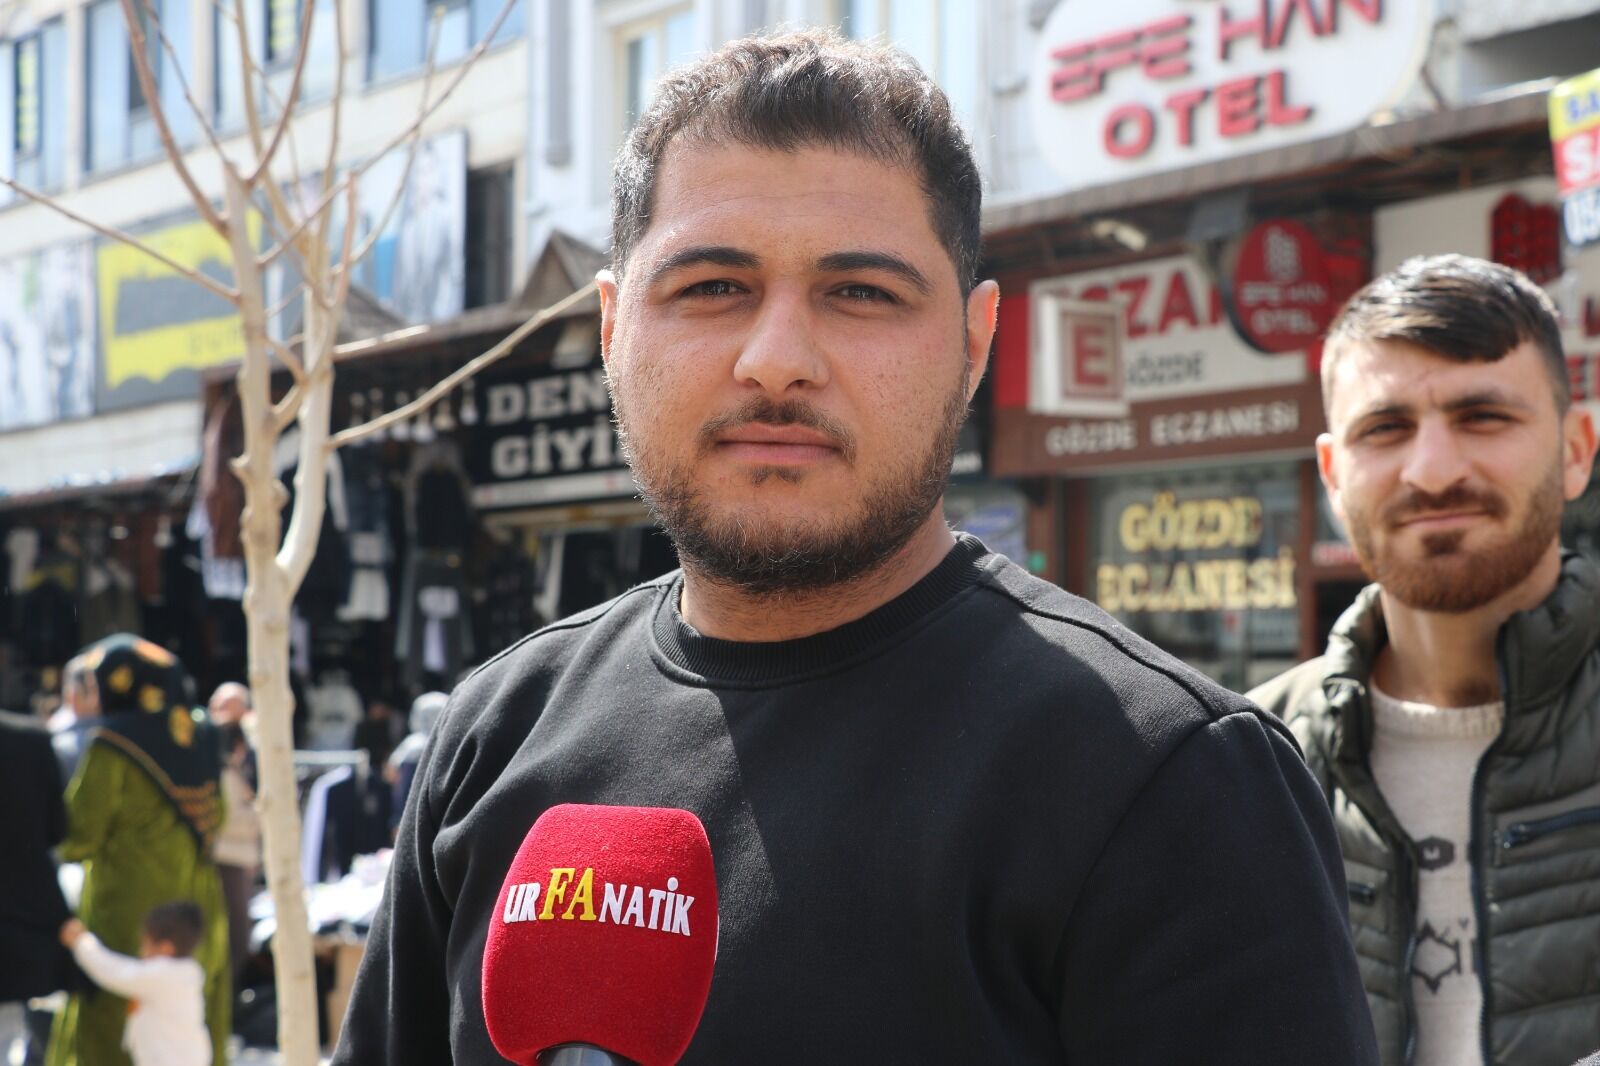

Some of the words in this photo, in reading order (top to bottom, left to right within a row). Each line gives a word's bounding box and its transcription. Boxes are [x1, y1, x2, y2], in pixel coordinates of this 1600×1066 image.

[1050, 14, 1193, 103] EFE
[1104, 70, 1313, 159] OTEL
[1074, 324, 1107, 387] E
[491, 412, 625, 478] GİYİ
[1046, 419, 1138, 455] GÖZDE
[1119, 490, 1263, 552] GÖZDE
[1097, 545, 1297, 612] ECZANESİ
[503, 867, 695, 937] URFANATİK
